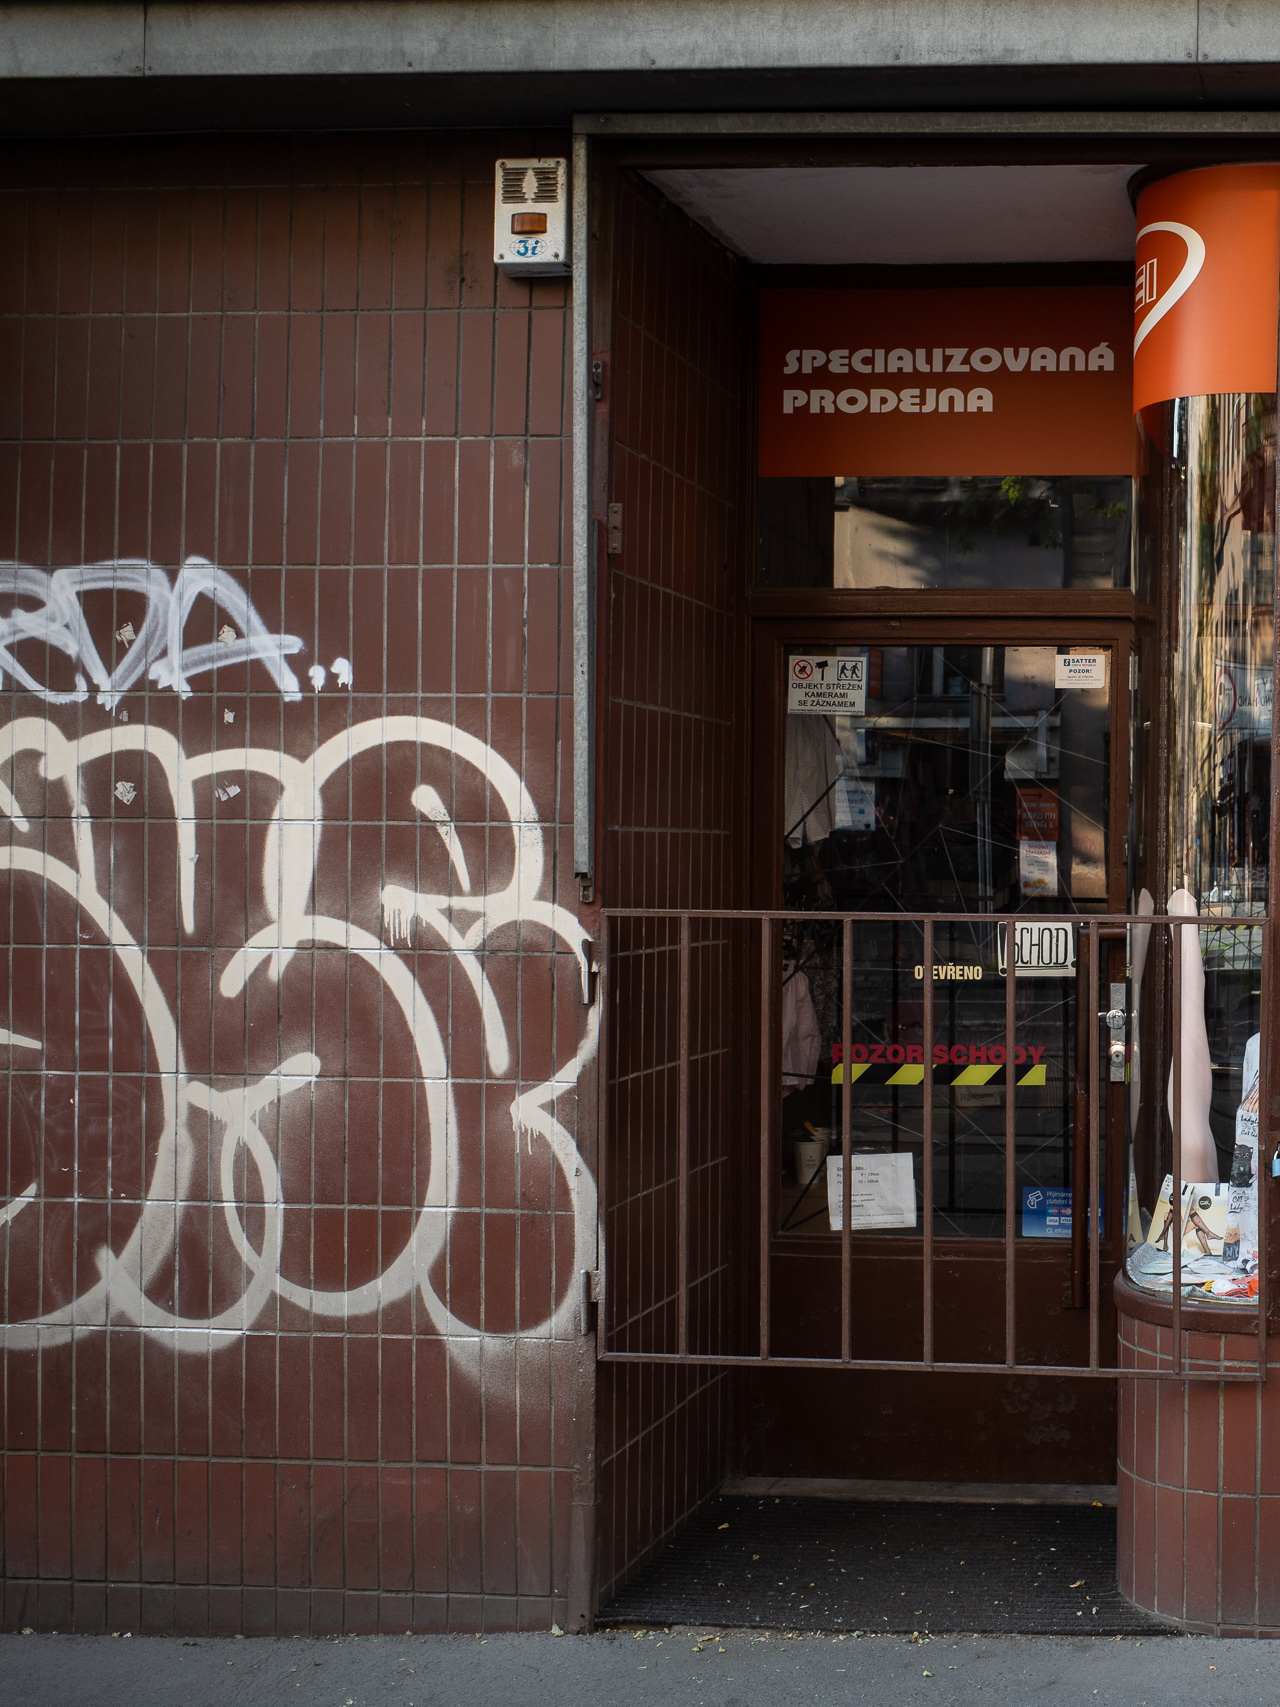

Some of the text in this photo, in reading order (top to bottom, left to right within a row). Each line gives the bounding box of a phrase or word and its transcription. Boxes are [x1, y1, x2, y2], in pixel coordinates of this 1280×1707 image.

[516, 239, 540, 256] 3i
[783, 342, 1115, 375] SPECIALIZOVANÁ
[783, 387, 994, 414] PRODEJNA
[791, 682, 863, 691] OBJEKT STŘEŽEN
[804, 691, 848, 699] KAMERAMI
[797, 699, 856, 708] SE ZÁZNAMEM
[914, 963, 982, 981] OEVŘENO
[832, 1043, 1046, 1065] POZOR SCHODY
